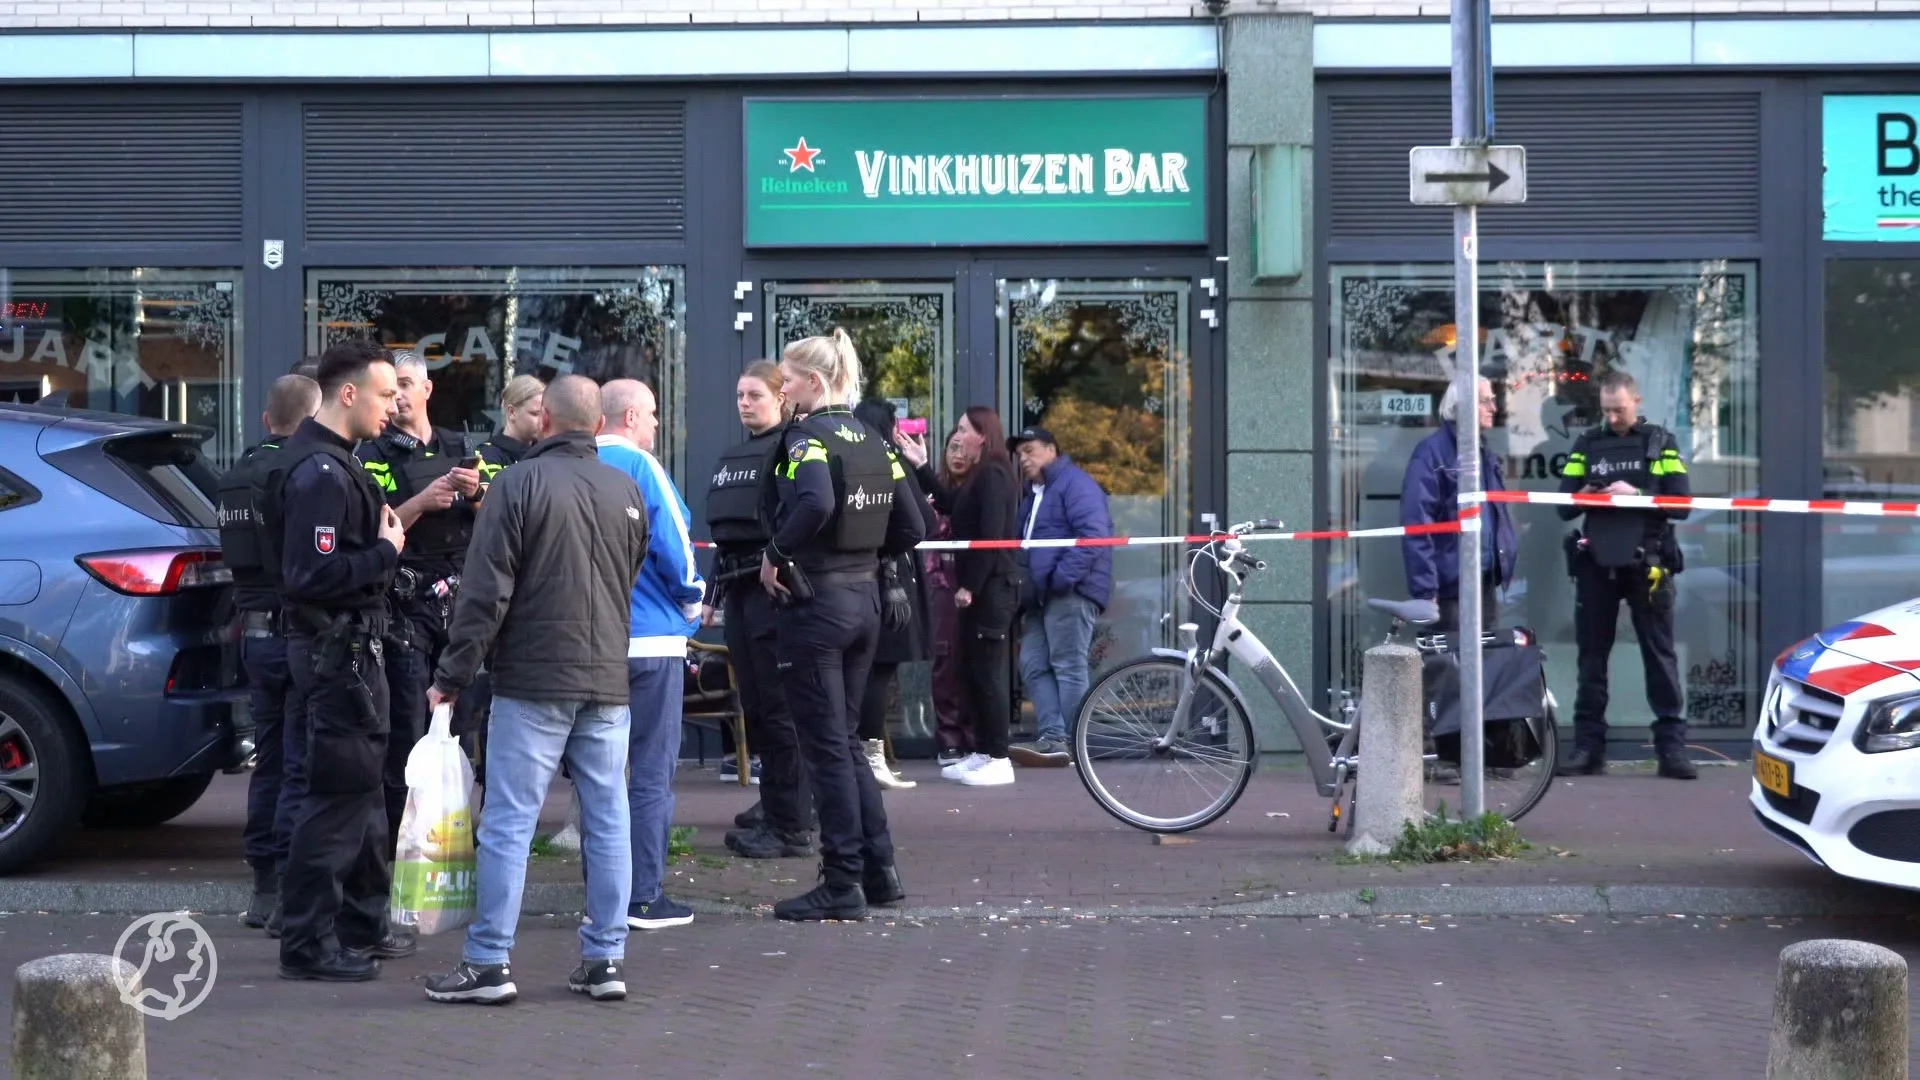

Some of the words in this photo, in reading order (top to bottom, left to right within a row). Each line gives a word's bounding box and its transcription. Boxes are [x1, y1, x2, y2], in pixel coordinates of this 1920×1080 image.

[855, 150, 1094, 197] VINKHUIZEN
[1104, 149, 1190, 195] BAR
[761, 177, 848, 193] Heineken
[415, 326, 582, 373] CAFE
[1388, 398, 1425, 412] 428/6
[713, 465, 757, 486] POLITIE
[847, 485, 893, 510] POLITIE
